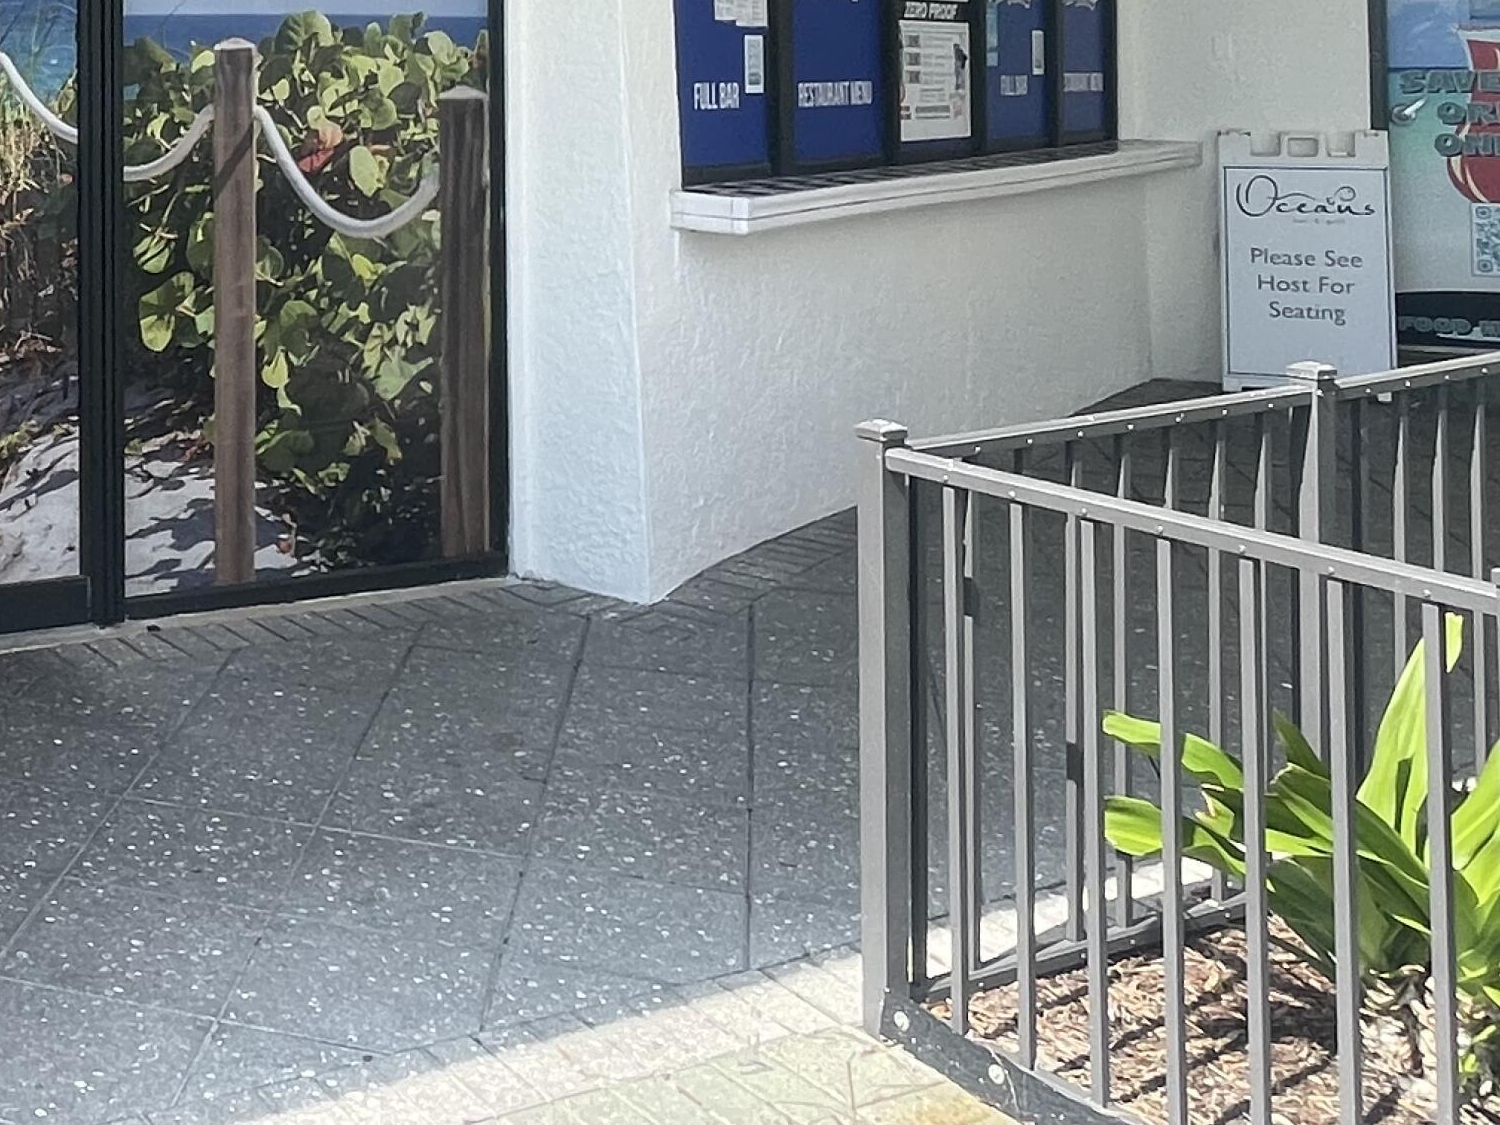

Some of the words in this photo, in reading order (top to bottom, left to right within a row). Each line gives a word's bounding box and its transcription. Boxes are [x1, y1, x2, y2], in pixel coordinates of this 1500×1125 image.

[693, 83, 717, 110] FULL
[719, 82, 740, 109] BAR
[1236, 175, 1376, 217] Oceans
[1251, 247, 1316, 266] Please
[1325, 250, 1363, 268] See
[1257, 275, 1310, 293] Host
[1319, 276, 1355, 294] For
[1269, 301, 1347, 326] Seating
